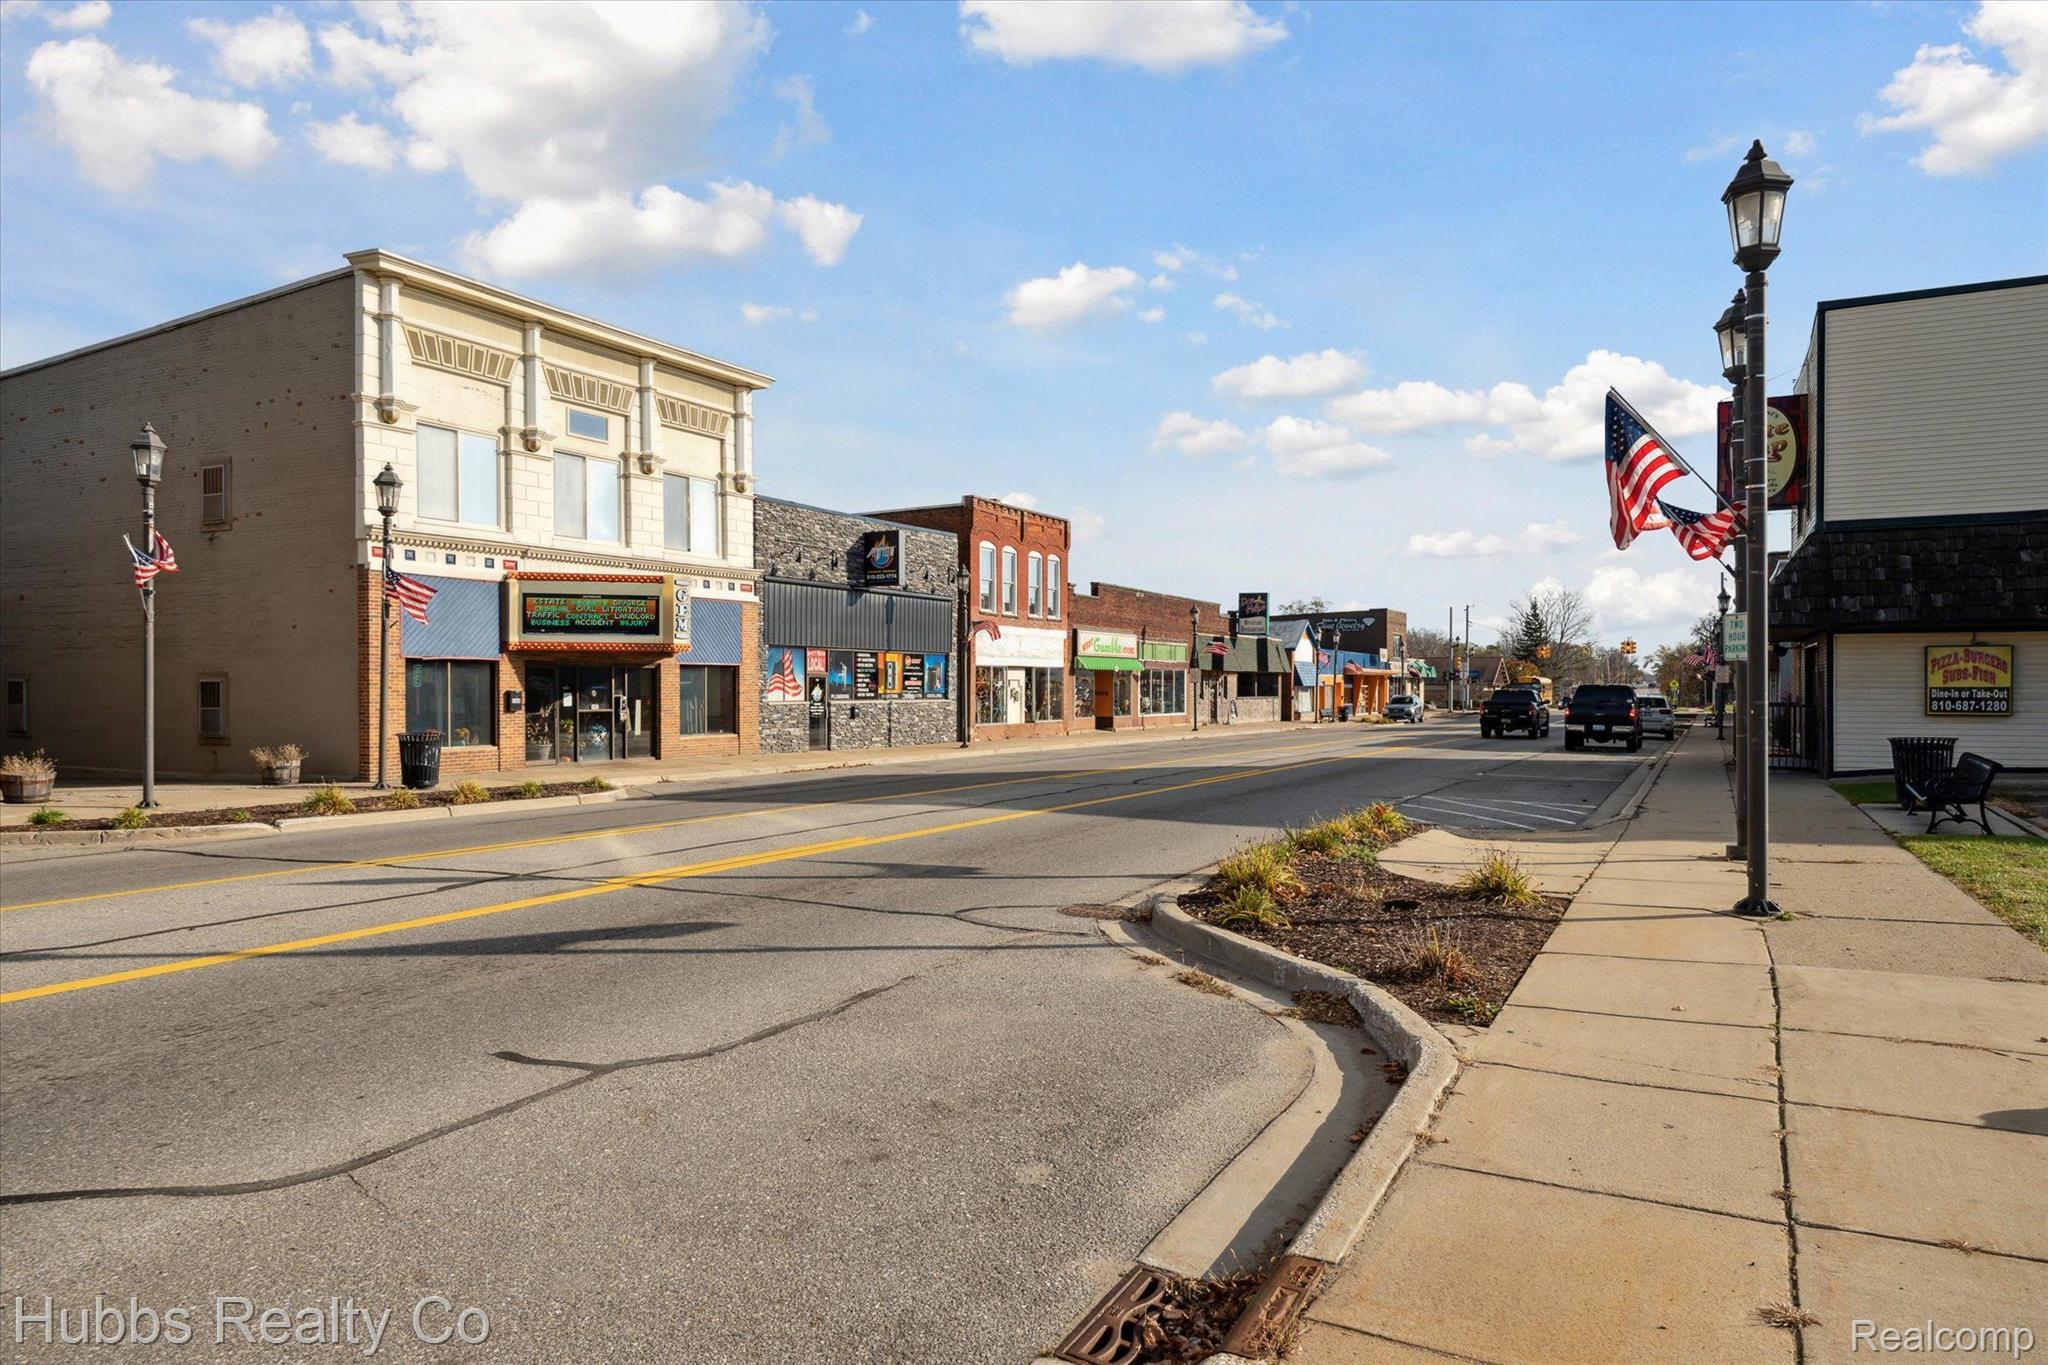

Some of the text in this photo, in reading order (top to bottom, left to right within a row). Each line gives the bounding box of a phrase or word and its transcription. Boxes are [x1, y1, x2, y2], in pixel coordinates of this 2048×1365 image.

[675, 588, 689, 632] GEM
[1730, 620, 1744, 629] TWO
[1728, 632, 1745, 641] HOUR
[1725, 644, 1748, 652] PARKIN
[1931, 689, 1959, 698] Dine-In
[1972, 689, 2008, 698] Take-Out
[1931, 700, 2007, 711] 810-687-1280
